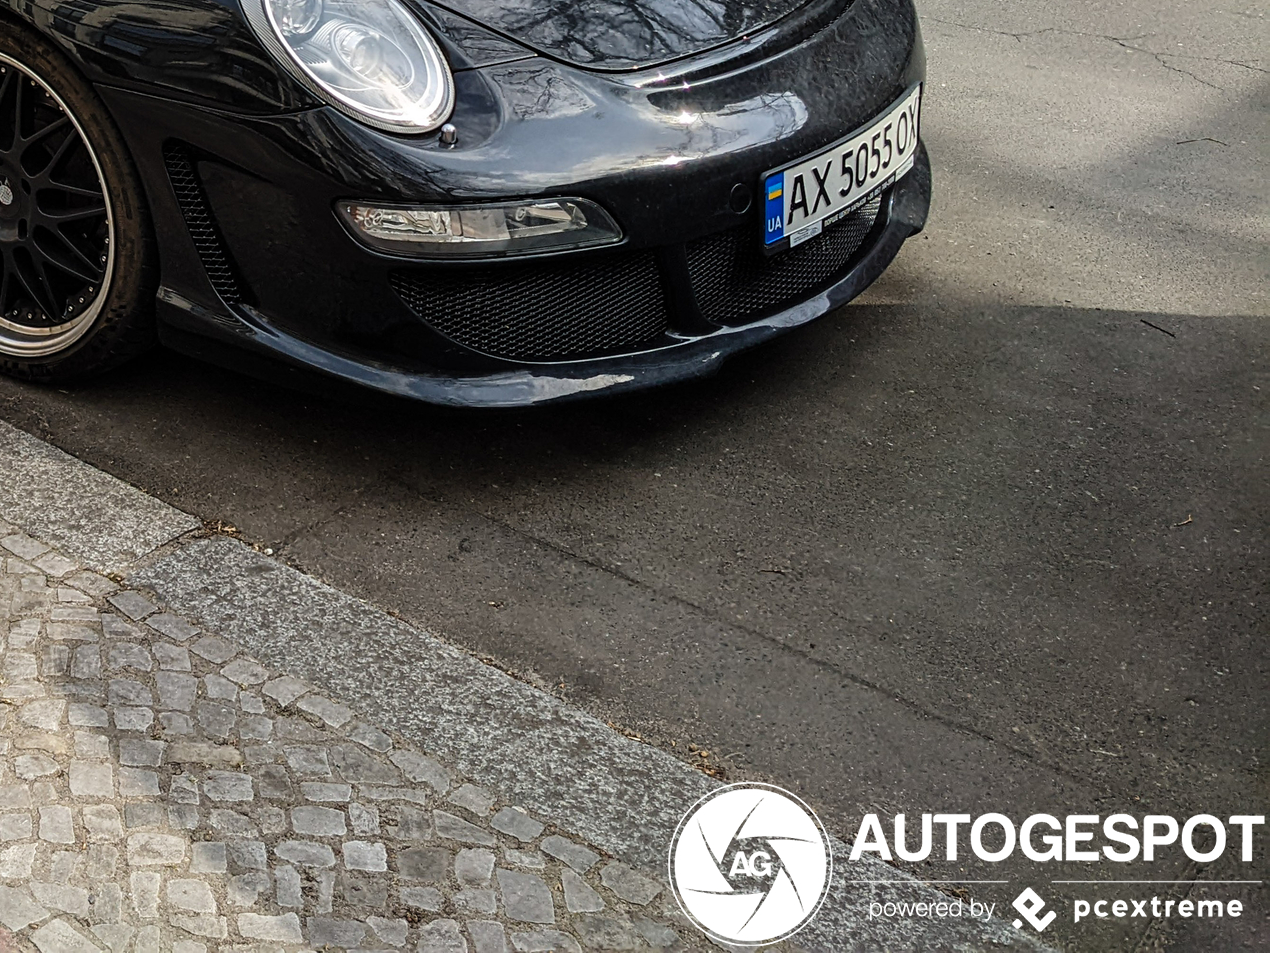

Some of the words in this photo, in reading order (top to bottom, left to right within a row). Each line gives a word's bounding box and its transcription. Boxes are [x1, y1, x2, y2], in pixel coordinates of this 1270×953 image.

[786, 159, 832, 226] AX
[839, 122, 892, 197] 5055
[896, 95, 919, 156] OX
[768, 216, 782, 232] UA
